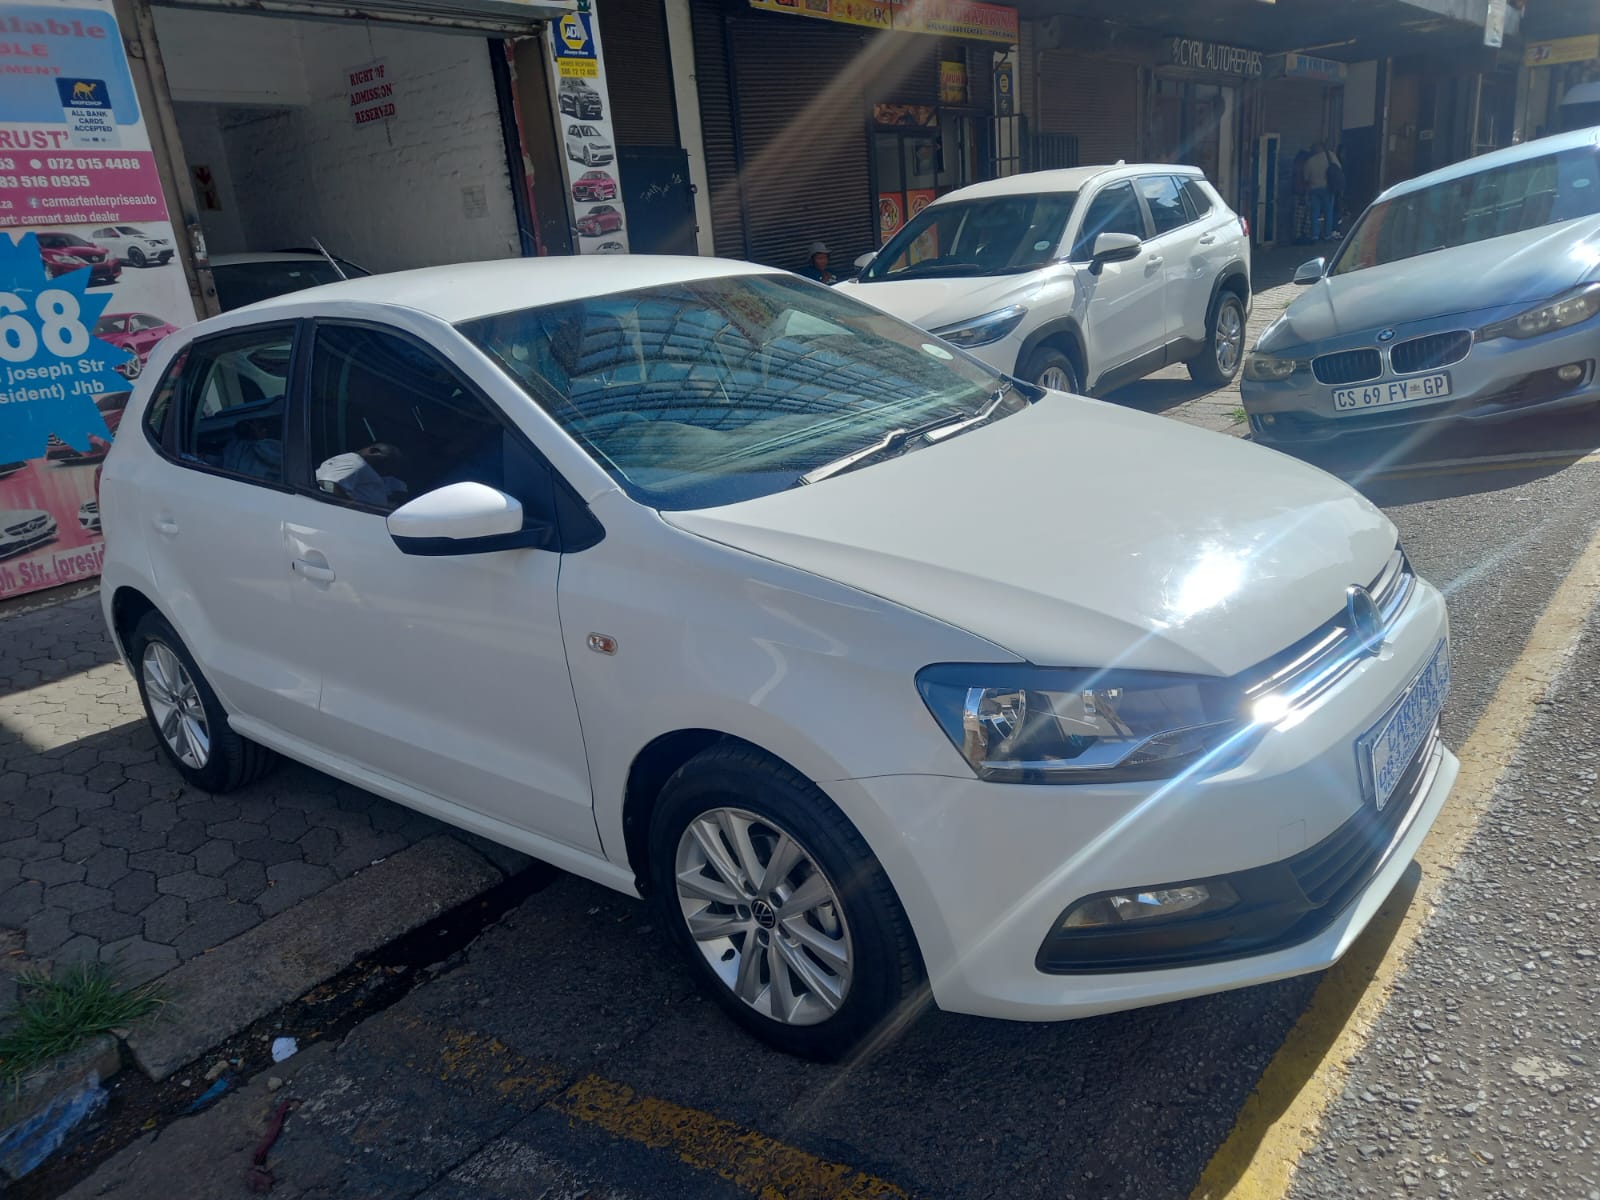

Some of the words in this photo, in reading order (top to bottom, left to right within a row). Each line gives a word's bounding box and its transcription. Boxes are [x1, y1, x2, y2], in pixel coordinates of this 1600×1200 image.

[0, 64, 60, 76] MENT
[351, 68, 373, 86] RIGHT
[355, 103, 395, 123] RESERVED
[47, 157, 74, 170] 072
[76, 157, 103, 170] 015
[105, 157, 141, 170] 4488
[20, 175, 49, 188] 516
[50, 175, 91, 188] 0935
[42, 194, 157, 209] carmartenterpriseauto
[21, 213, 62, 225] carmart
[64, 212, 88, 223] auto
[89, 210, 120, 223] dealer
[6, 361, 73, 385] joseph
[78, 359, 105, 373] Str
[0, 383, 65, 404] sident)
[71, 379, 105, 396] Jhb
[1337, 390, 1356, 407] CS
[1363, 386, 1381, 404] 69
[1388, 382, 1407, 401] FY
[1423, 376, 1443, 395] GP
[19, 561, 51, 584] Str.
